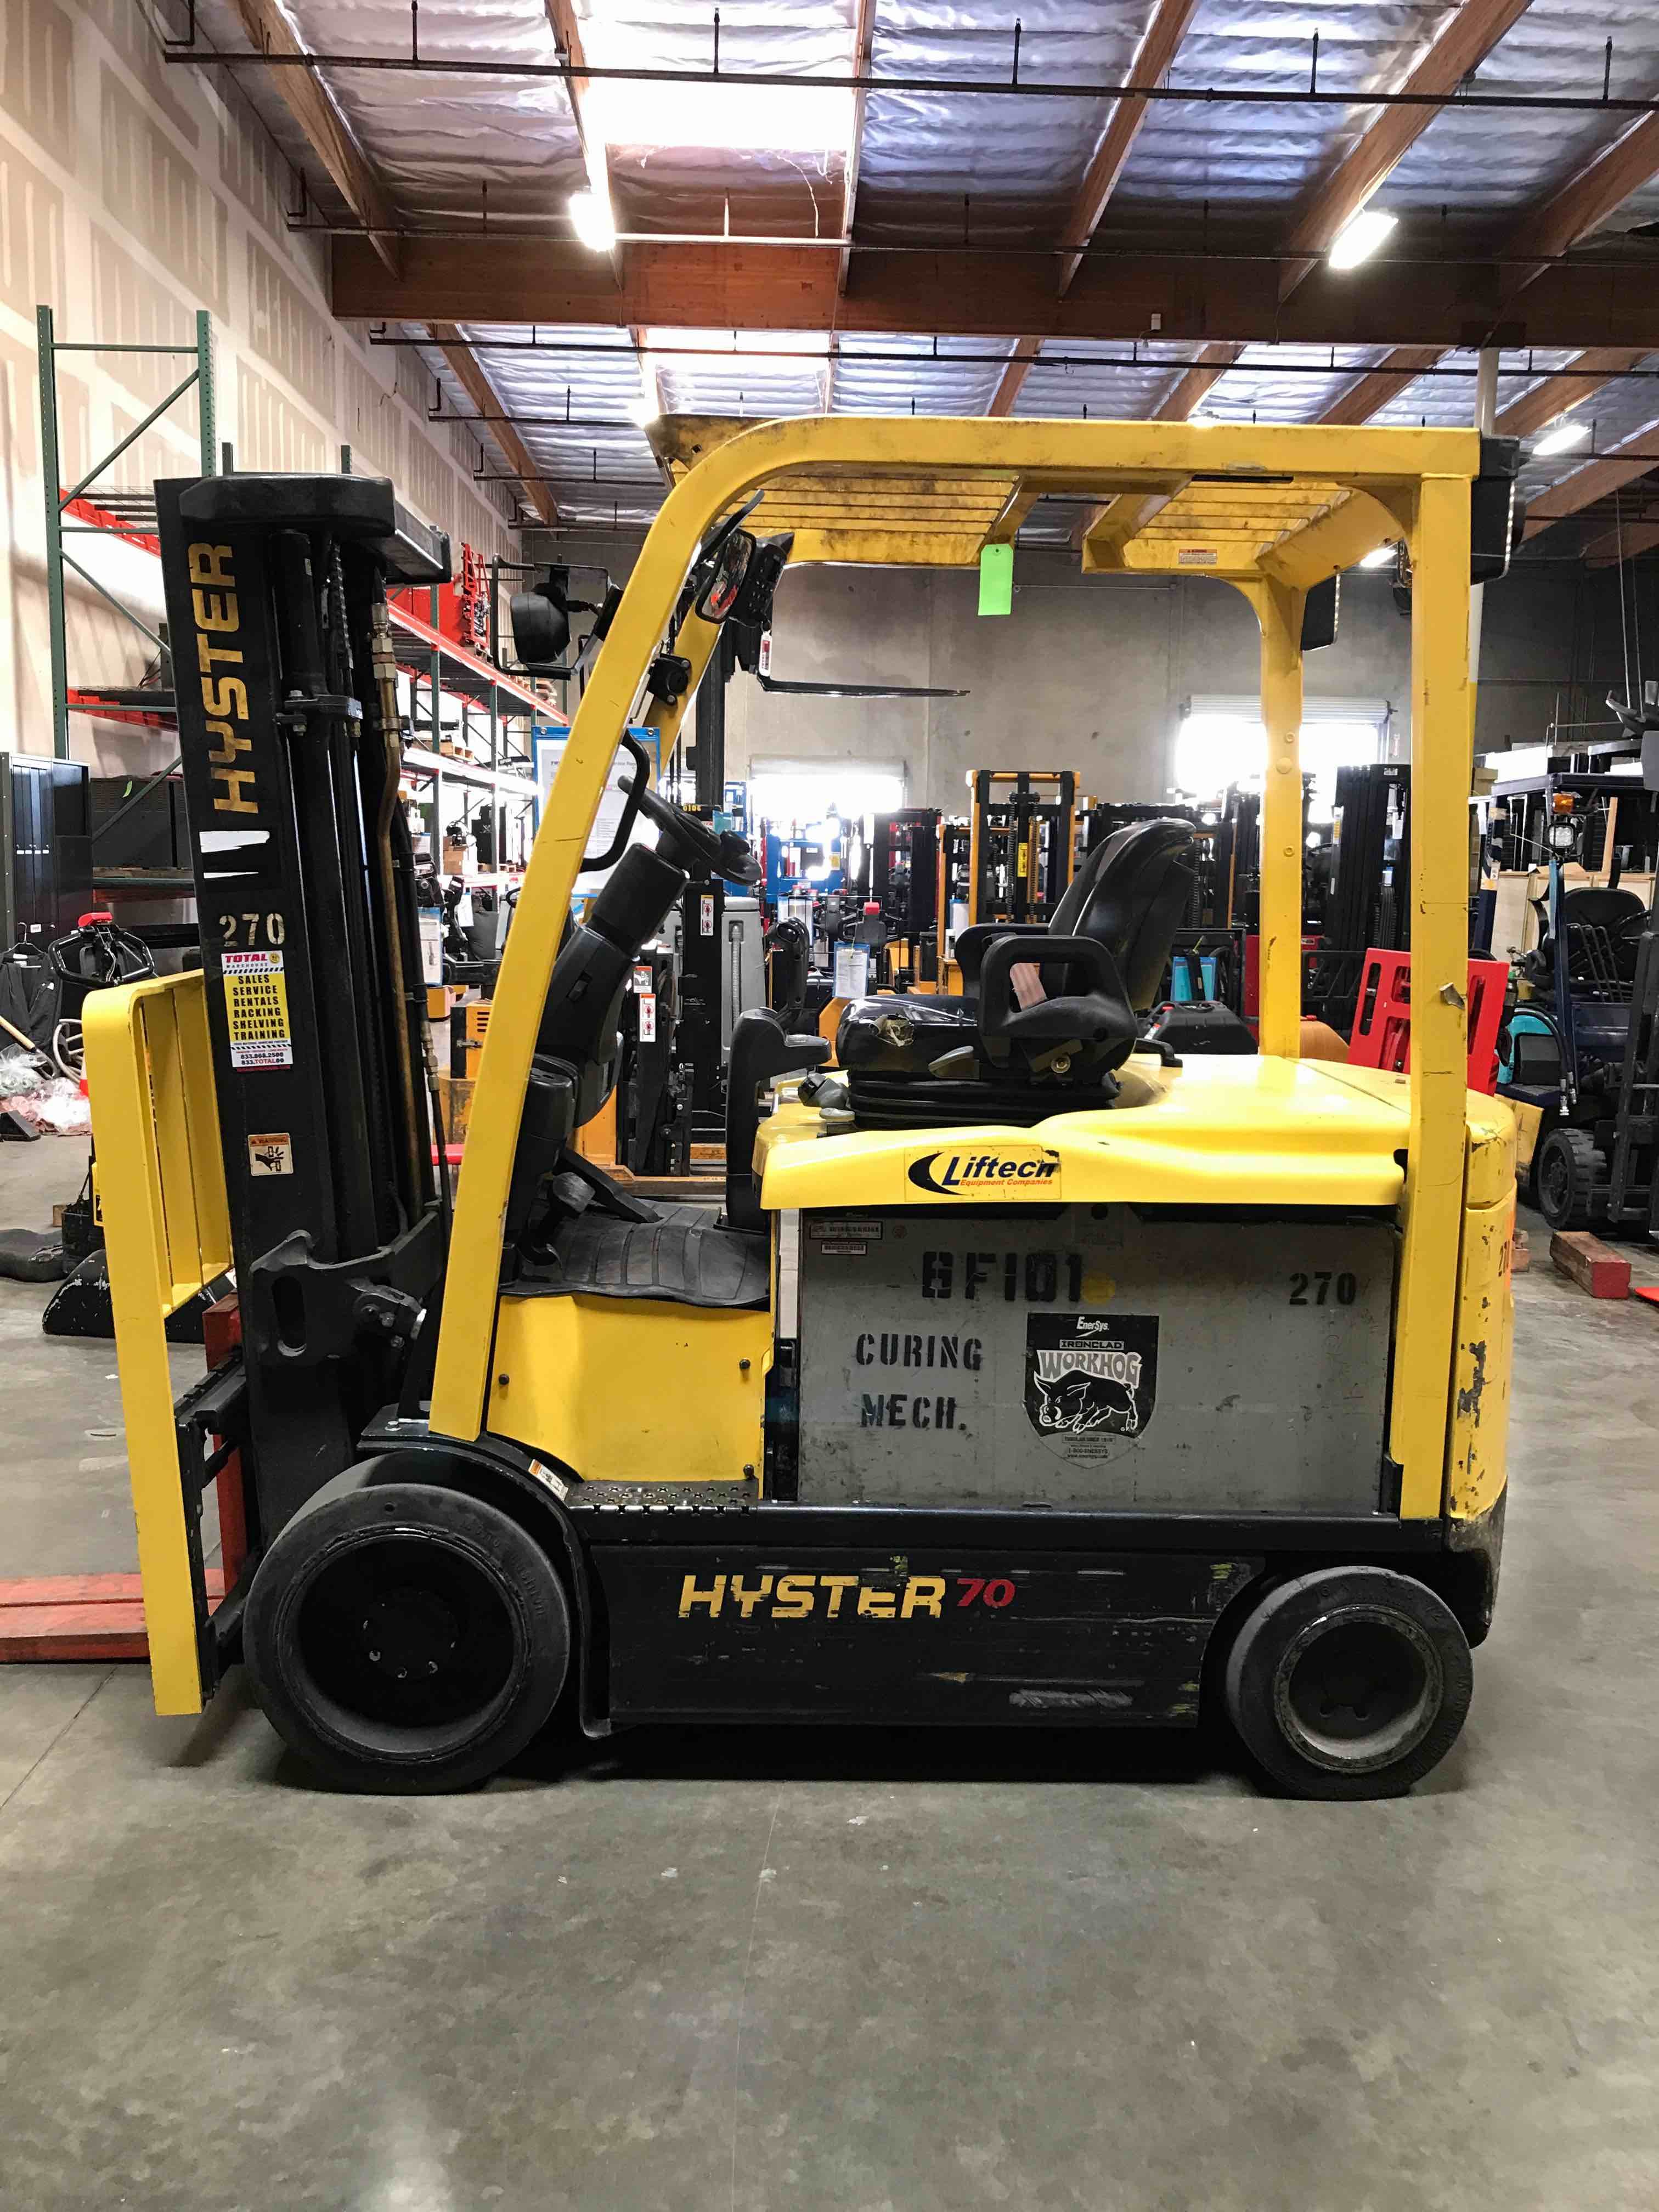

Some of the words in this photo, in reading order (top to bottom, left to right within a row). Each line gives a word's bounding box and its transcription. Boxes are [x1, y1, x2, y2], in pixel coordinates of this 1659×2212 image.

[188, 543, 259, 814] HYSTER
[219, 913, 285, 947] 270
[225, 953, 268, 963] TOTAL
[238, 974, 269, 984] SALES
[233, 985, 277, 996] SERVICE
[234, 996, 279, 1007] RENTALS
[234, 1007, 281, 1018] RACKING
[233, 1018, 284, 1030] SHELVING
[234, 1029, 285, 1041] TRAINING
[941, 1156, 1060, 1186] Liftech
[1289, 1271, 1356, 1306] 270
[1062, 1340, 1122, 1348] IRONCLAD
[856, 1333, 982, 1370] CURING
[1040, 1352, 1141, 1387] WORKHOG
[678, 1574, 946, 1618] HYSTER
[956, 1578, 1015, 1607] 70
